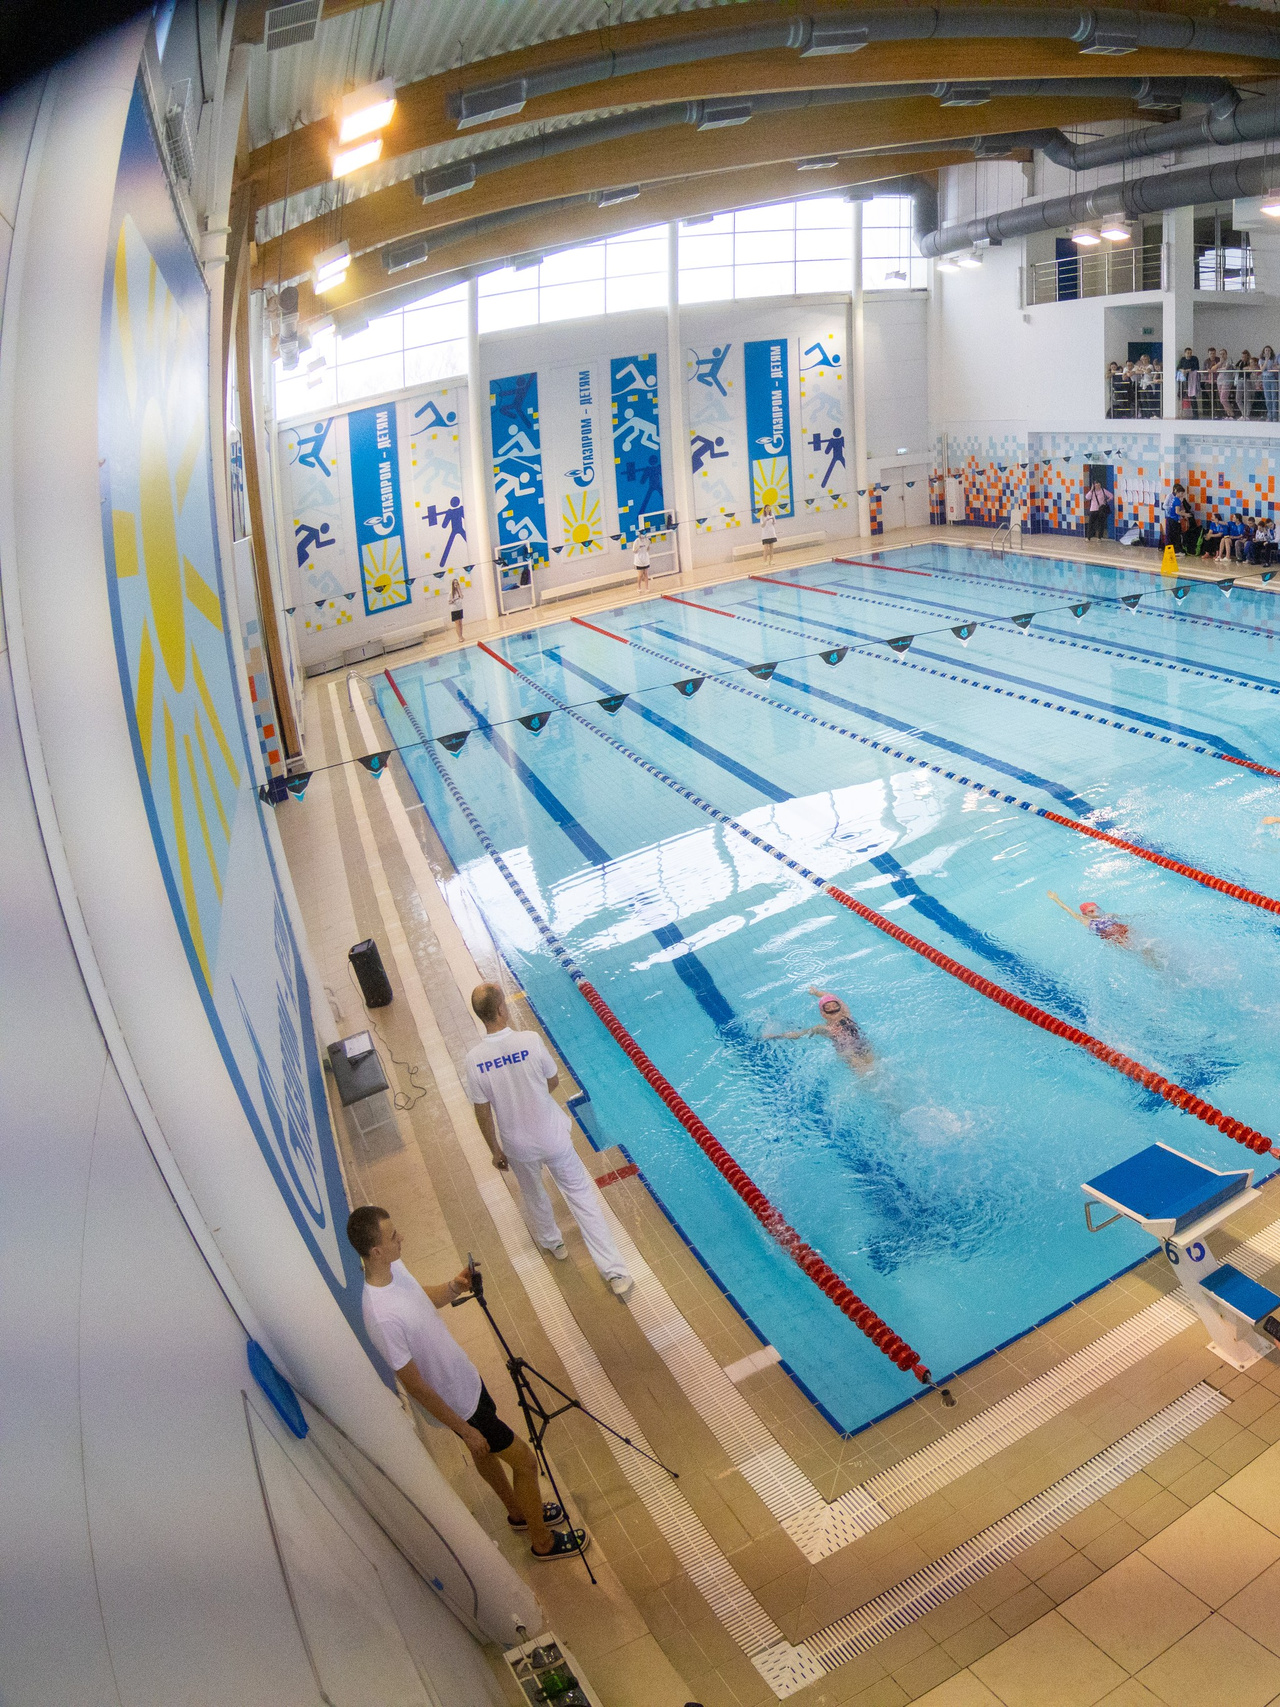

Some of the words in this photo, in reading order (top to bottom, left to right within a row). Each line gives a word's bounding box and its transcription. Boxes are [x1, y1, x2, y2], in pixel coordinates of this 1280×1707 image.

[770, 345, 783, 378] ДЕТЯМ
[579, 370, 592, 405] ДЕТЯМ
[376, 411, 392, 449] ДЕТЯМ
[771, 390, 784, 435] ГАЗПРОМ
[580, 418, 594, 466] ГАЗПРОМ
[379, 461, 394, 513] ГАЗПРОМ
[476, 1049, 529, 1074] ТРЕНЕР
[1165, 1241, 1179, 1265] 6
